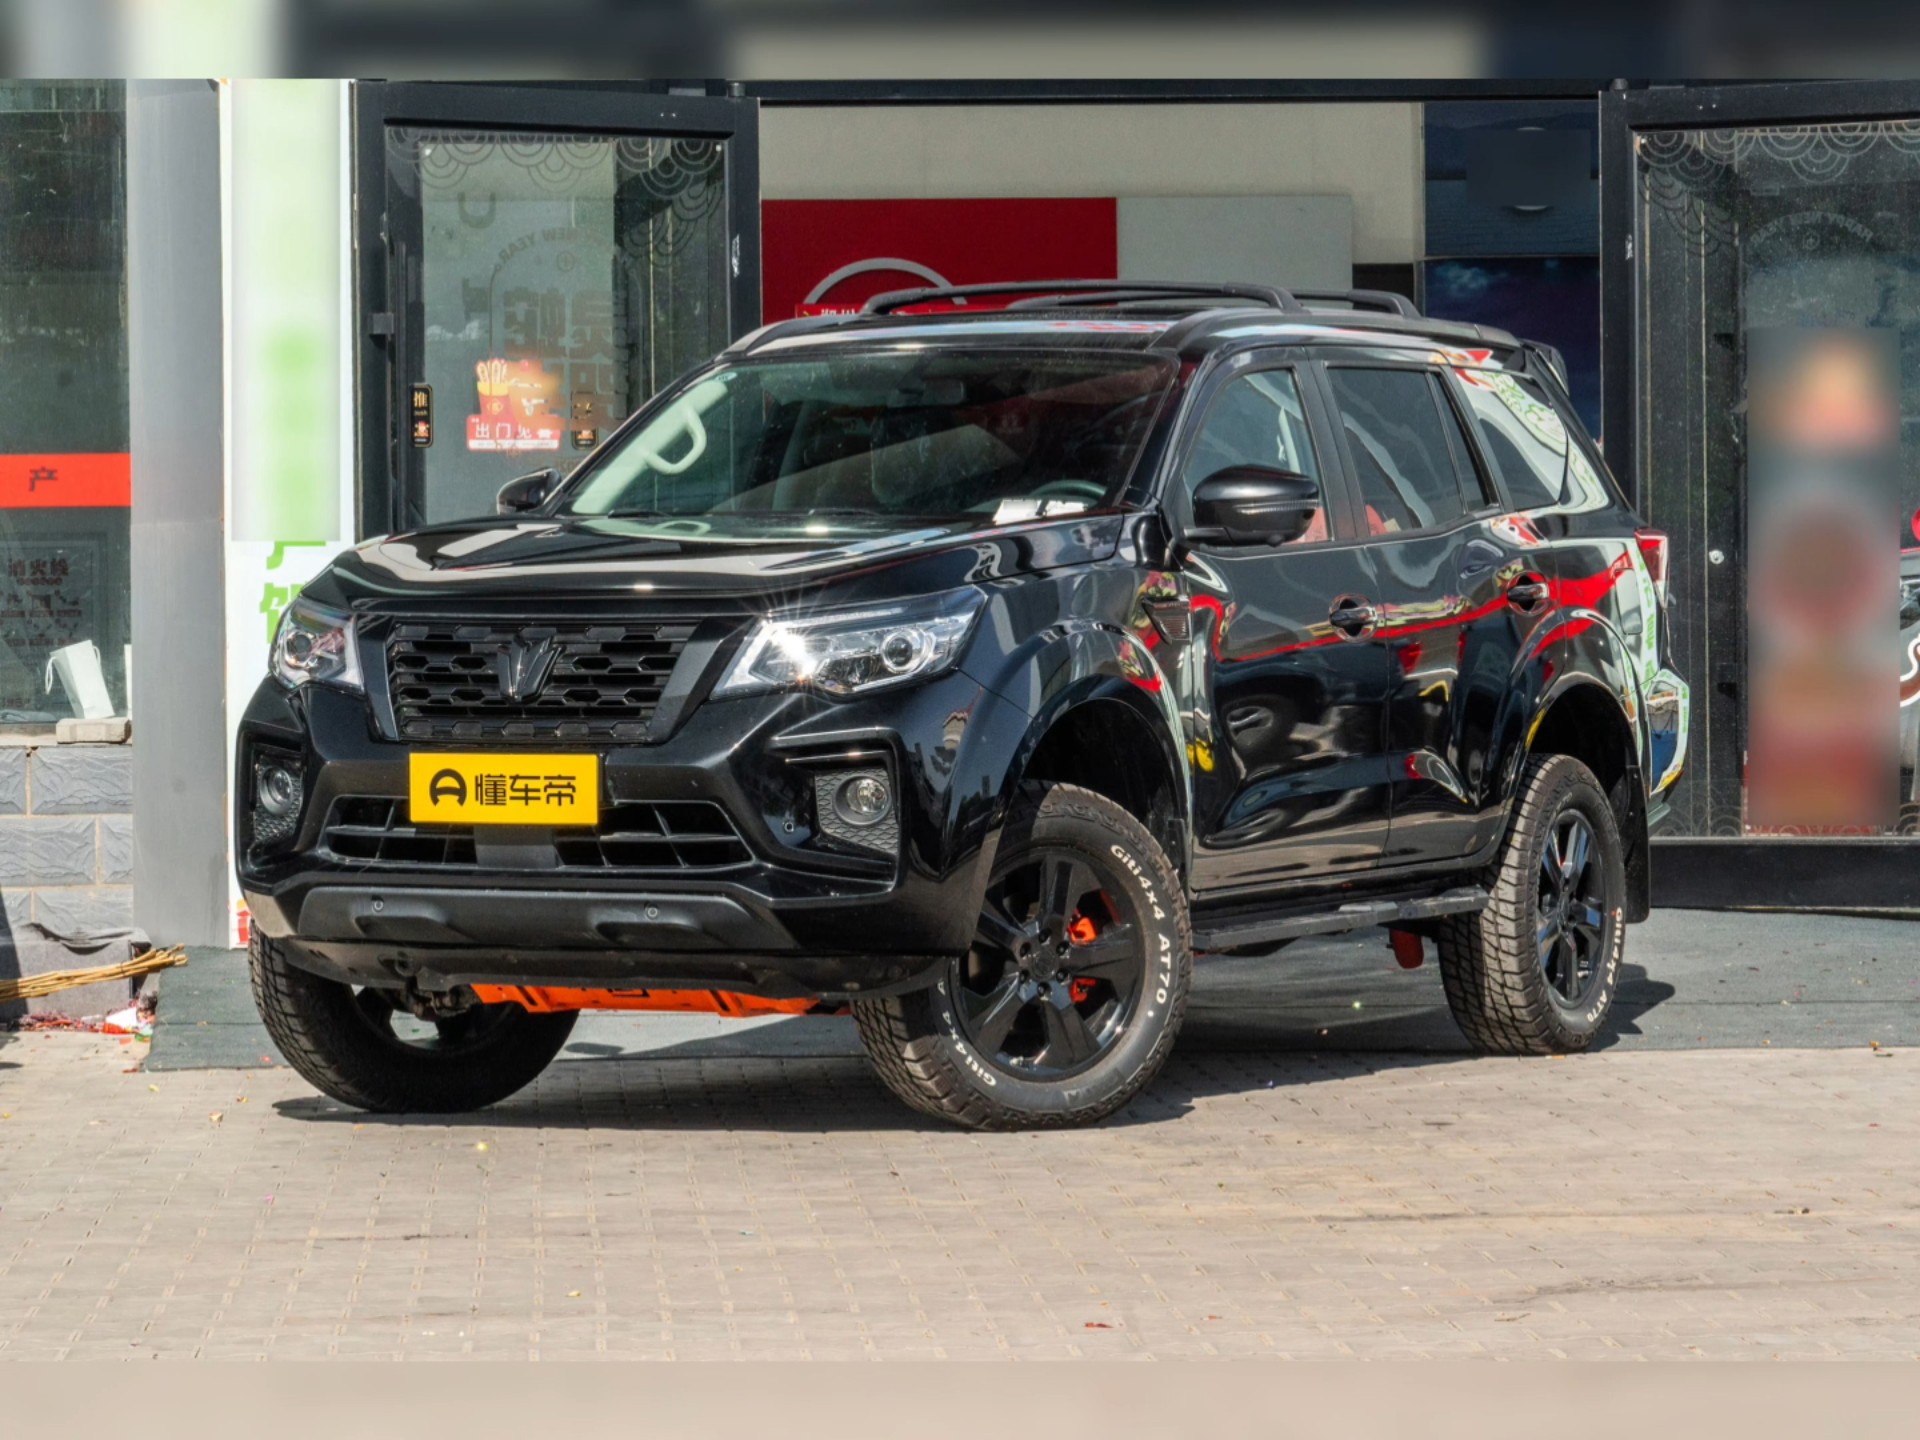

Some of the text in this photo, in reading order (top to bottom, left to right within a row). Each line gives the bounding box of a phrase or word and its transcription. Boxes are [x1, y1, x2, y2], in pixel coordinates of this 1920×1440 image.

[29, 466, 58, 492] 产
[475, 774, 576, 807] 懂车帝
[1156, 932, 1172, 1004] AT70
